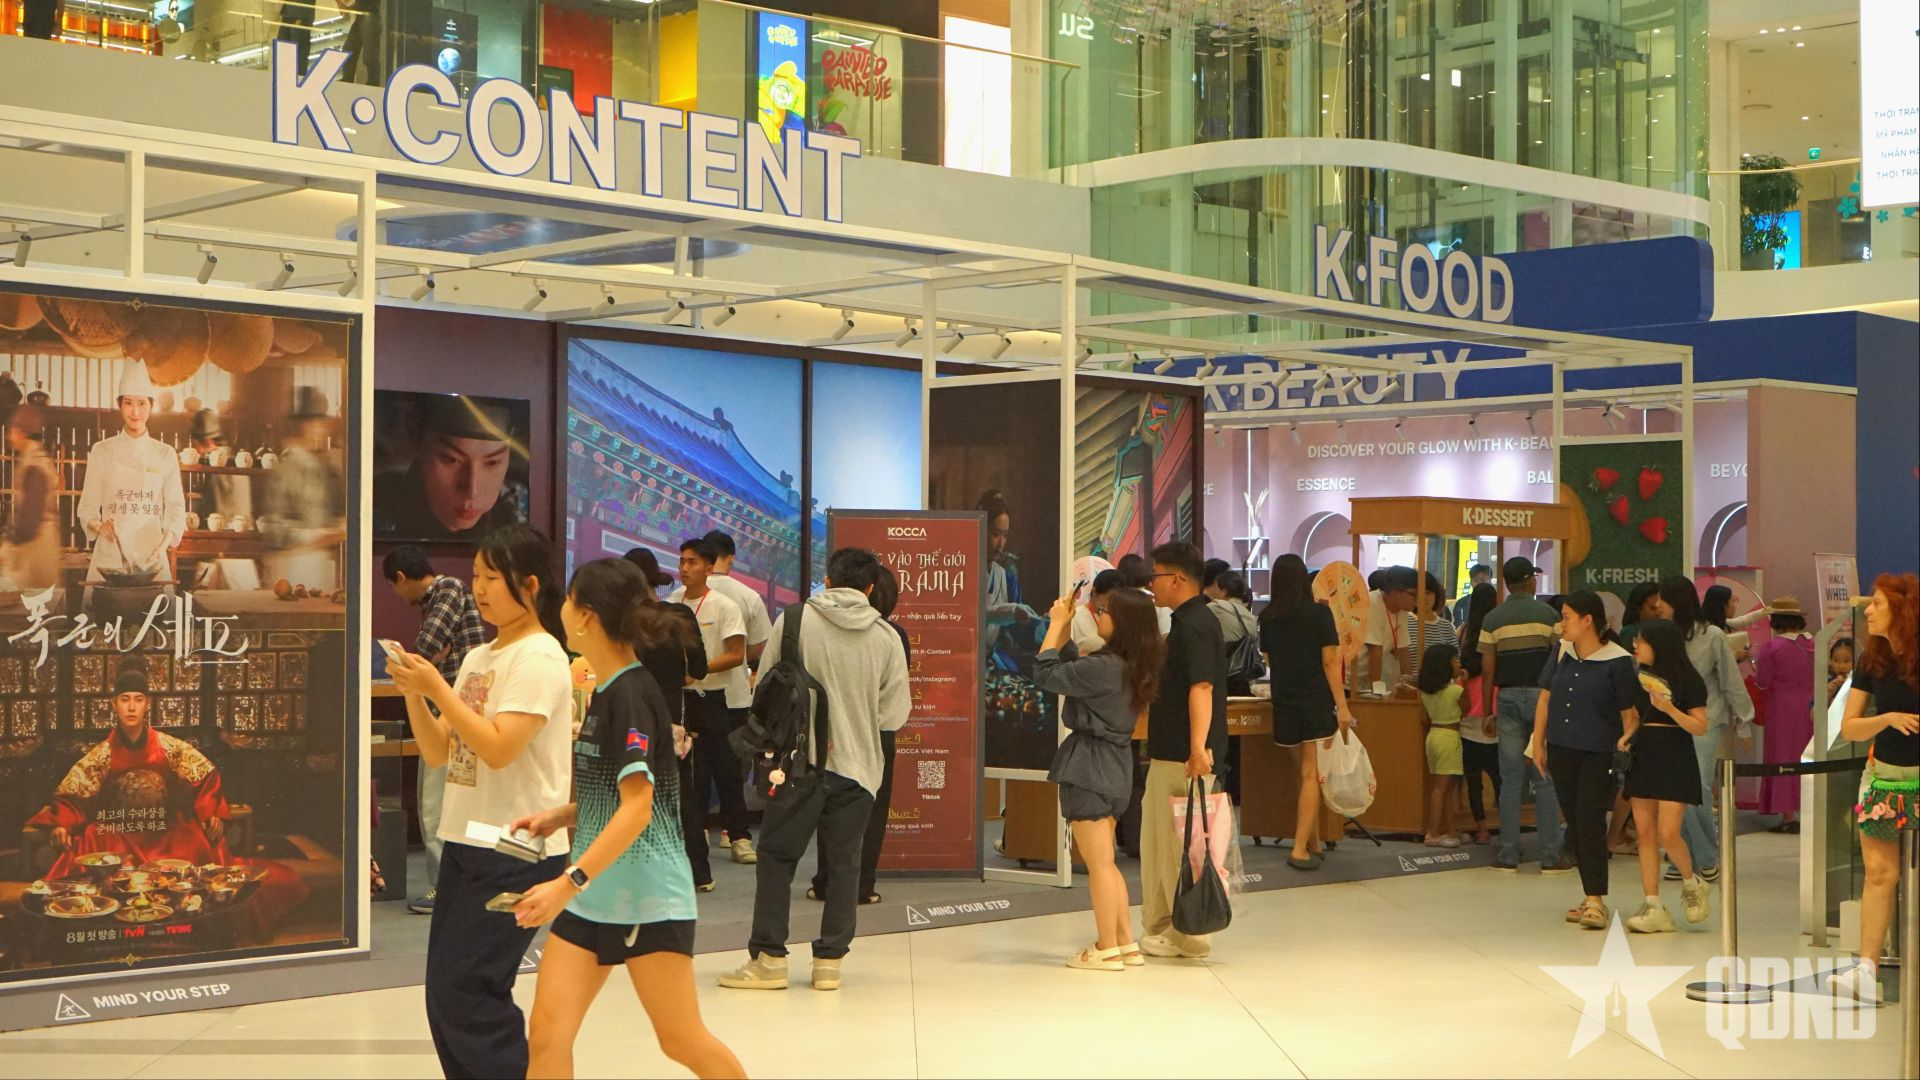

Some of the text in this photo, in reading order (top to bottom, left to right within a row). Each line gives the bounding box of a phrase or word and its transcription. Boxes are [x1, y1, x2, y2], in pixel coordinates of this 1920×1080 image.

[1308, 443, 1374, 458] DISCOVER
[1378, 441, 1415, 456] YOUR
[1418, 439, 1460, 455] GLOW
[1464, 437, 1501, 453] WITH
[1297, 477, 1356, 491] ESSENCE
[115, 489, 154, 501] 폭군마저
[108, 502, 161, 516] 평생 못 잊을
[887, 527, 928, 537] KOCCA
[887, 549, 912, 569] VÀO
[916, 548, 942, 569] THẾ
[943, 550, 966, 567] GIỚI
[1825, 587, 1850, 601] WHEEL
[949, 613, 962, 622] tay
[7, 584, 250, 670] 폭군의 셰프
[96, 807, 167, 821] 최고의 수라상을
[96, 820, 167, 835] 준비하도록 하죠
[927, 900, 1011, 917] MIND YOUR STEP
[66, 931, 85, 944] 8월
[87, 930, 96, 942] 첫
[98, 930, 116, 941] 방송
[92, 983, 231, 1009] MIND YOUR STEP
